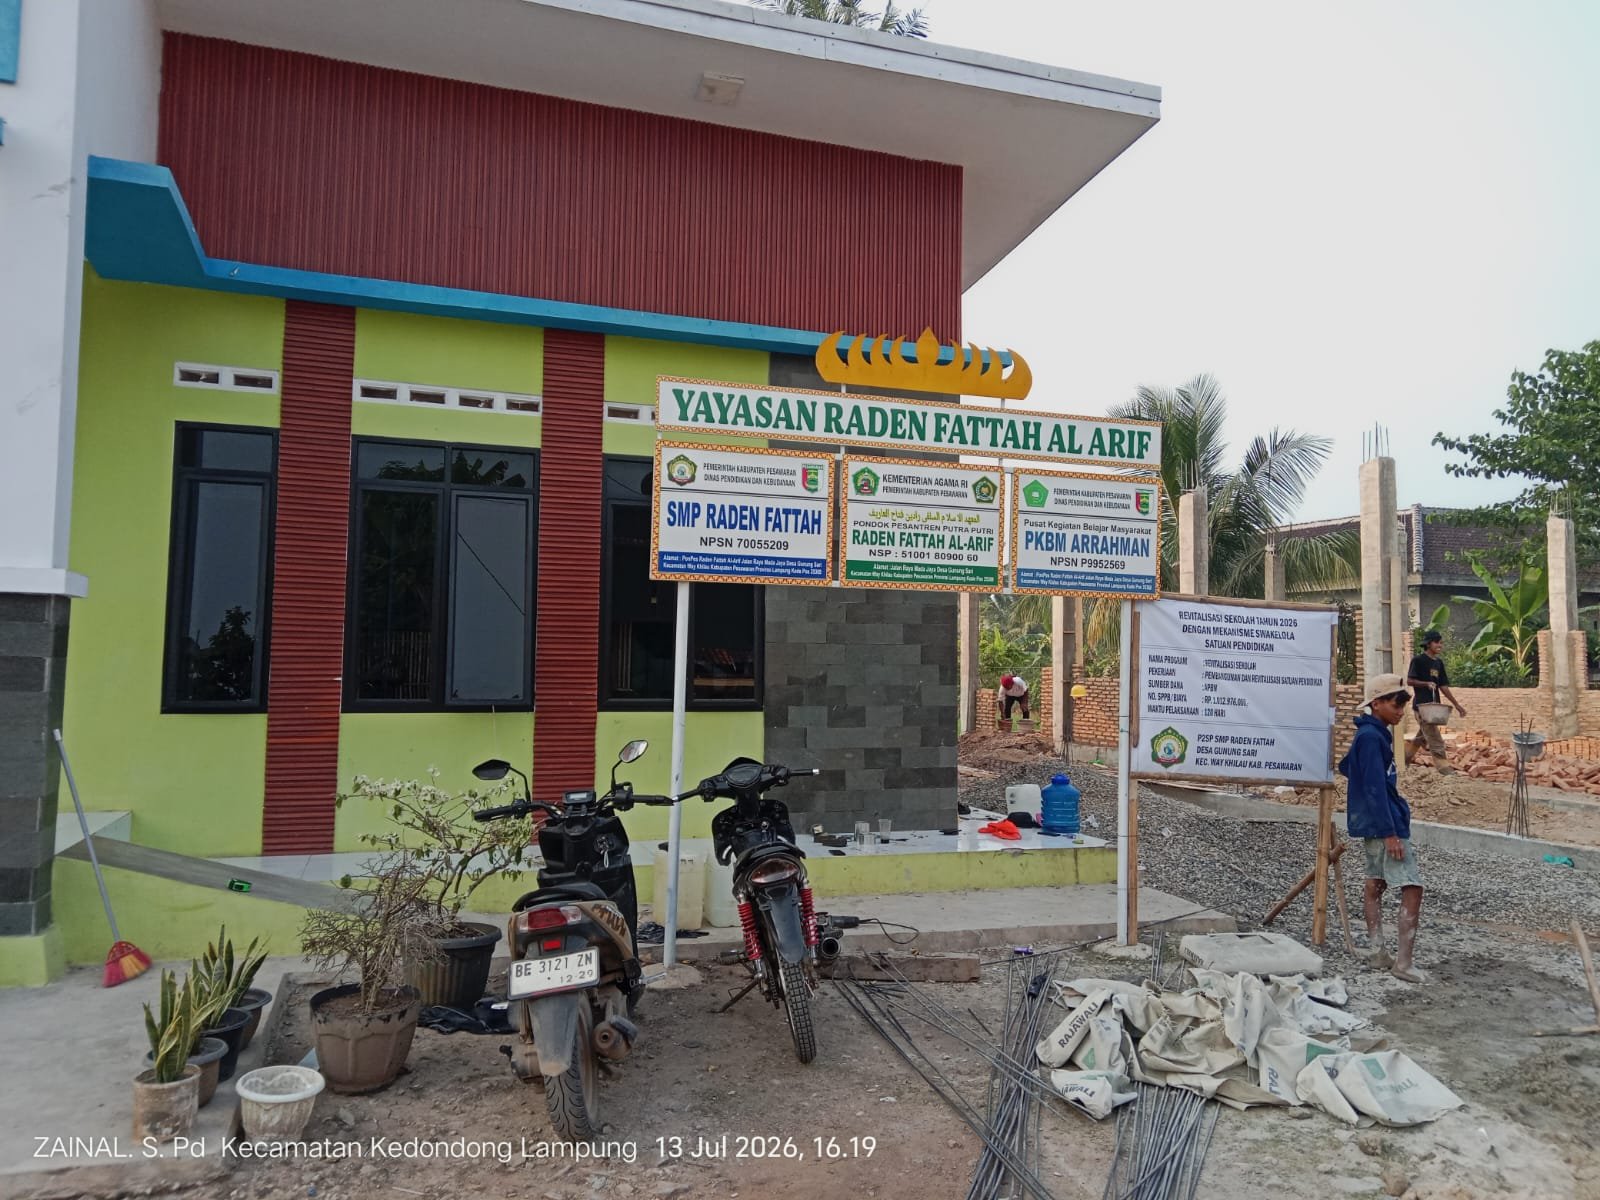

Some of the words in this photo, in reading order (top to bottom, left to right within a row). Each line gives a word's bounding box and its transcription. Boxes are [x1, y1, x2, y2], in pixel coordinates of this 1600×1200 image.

[672, 388, 817, 431] YAYASAN
[824, 402, 927, 442] RADEN
[933, 412, 1042, 451] FATTAH
[1046, 424, 1082, 455] AL
[1088, 427, 1152, 460] ARIF
[704, 462, 736, 473] PEMERINTAH
[737, 464, 766, 475] KABUPATEN
[766, 467, 797, 477] PESAWARAN
[704, 473, 719, 482] DINAS
[720, 474, 751, 484] PENDIDIKAN
[752, 477, 762, 485] DAN
[764, 478, 796, 487] KEBUDAYAAN
[882, 474, 932, 486] KEMENTERIAN
[934, 478, 960, 489] AGAMA
[961, 480, 968, 489] RI
[882, 486, 912, 495] PEMERINTAH
[913, 488, 940, 496] KABUPATEN
[941, 490, 968, 498] PESAWARAN
[1054, 488, 1080, 497] PEMERINTAH
[1080, 490, 1106, 498] KABUPATEN
[1106, 492, 1132, 501] PESAWARAN
[1054, 498, 1068, 506] DINAS
[1068, 500, 1094, 508] PENDIDIKAN
[1104, 502, 1130, 510] KEBUDAYAAN
[666, 501, 700, 528] SMP
[706, 503, 760, 531] RADEN
[764, 506, 822, 535] FATTAH
[854, 520, 890, 530] PONDOK
[892, 522, 940, 532] PESANTREN
[942, 525, 970, 534] PUTRA
[970, 527, 994, 536] PUTRI
[1024, 519, 1046, 528] Pusat
[1048, 521, 1080, 532] Kegiatan
[1083, 523, 1109, 534] Belajar
[1111, 525, 1152, 536] Masyarakat
[700, 536, 733, 549] NPSN
[737, 539, 788, 551] 70055209
[852, 528, 896, 548] RADEN
[900, 531, 945, 550] FATTAH
[948, 534, 994, 552] AL-ARIF
[1024, 530, 1066, 552] PKBM
[1070, 534, 1150, 558] ARRAHMAN
[869, 548, 892, 559] NSP
[901, 551, 931, 561] 51001
[934, 552, 964, 562] 80900
[966, 554, 978, 564] 60
[1050, 557, 1078, 568] NPSN
[1080, 558, 1126, 570] P9952569
[1178, 610, 1222, 622] REVITALISASI
[1224, 614, 1254, 625] SEKOLAH
[1256, 617, 1278, 627] TAHUN
[1280, 618, 1298, 628] 2026
[1182, 624, 1211, 636] DENGAN
[1212, 626, 1254, 638] MEKANISME
[1256, 630, 1295, 641] SWAKELOLA
[1204, 639, 1231, 650] SATUAN
[1232, 640, 1274, 652] PENDIDIKAN
[1148, 654, 1164, 664] NAMA
[1164, 656, 1188, 665] PROGRAM
[1236, 662, 1256, 670] SEKOLAH
[1148, 667, 1176, 676] PEKERJAAN
[1204, 671, 1240, 682] PEMBANGUNAN
[1241, 674, 1251, 683] DAN
[1252, 674, 1280, 685] REVITALISASI
[1281, 676, 1298, 686] SATUAN
[1298, 678, 1323, 687] PENDIDIKAN
[1148, 680, 1170, 689] SUMBER
[1170, 680, 1184, 690] DANA
[1148, 692, 1156, 701] NO.
[1148, 704, 1165, 714] WAKTU
[1166, 706, 1200, 716] PELAKSANAAN
[1214, 709, 1226, 718] HARI
[1198, 734, 1214, 743] P2SP
[1214, 735, 1230, 744] SMP
[1230, 736, 1251, 746] RADEN
[1252, 738, 1275, 747] FATTAH
[1196, 746, 1212, 755] DESA
[1214, 747, 1241, 756] GUNUNG
[1242, 748, 1258, 758] SARI
[1195, 757, 1210, 766] KEC.
[1210, 758, 1225, 767] WAY
[1225, 759, 1248, 768] KHILAU
[1248, 760, 1262, 769] KAB.
[1264, 762, 1302, 772] PESAWARAN
[515, 963, 532, 978] BE
[539, 957, 568, 974] 3121
[577, 952, 593, 968] ZN
[1058, 1002, 1098, 1048] RAJAWALI
